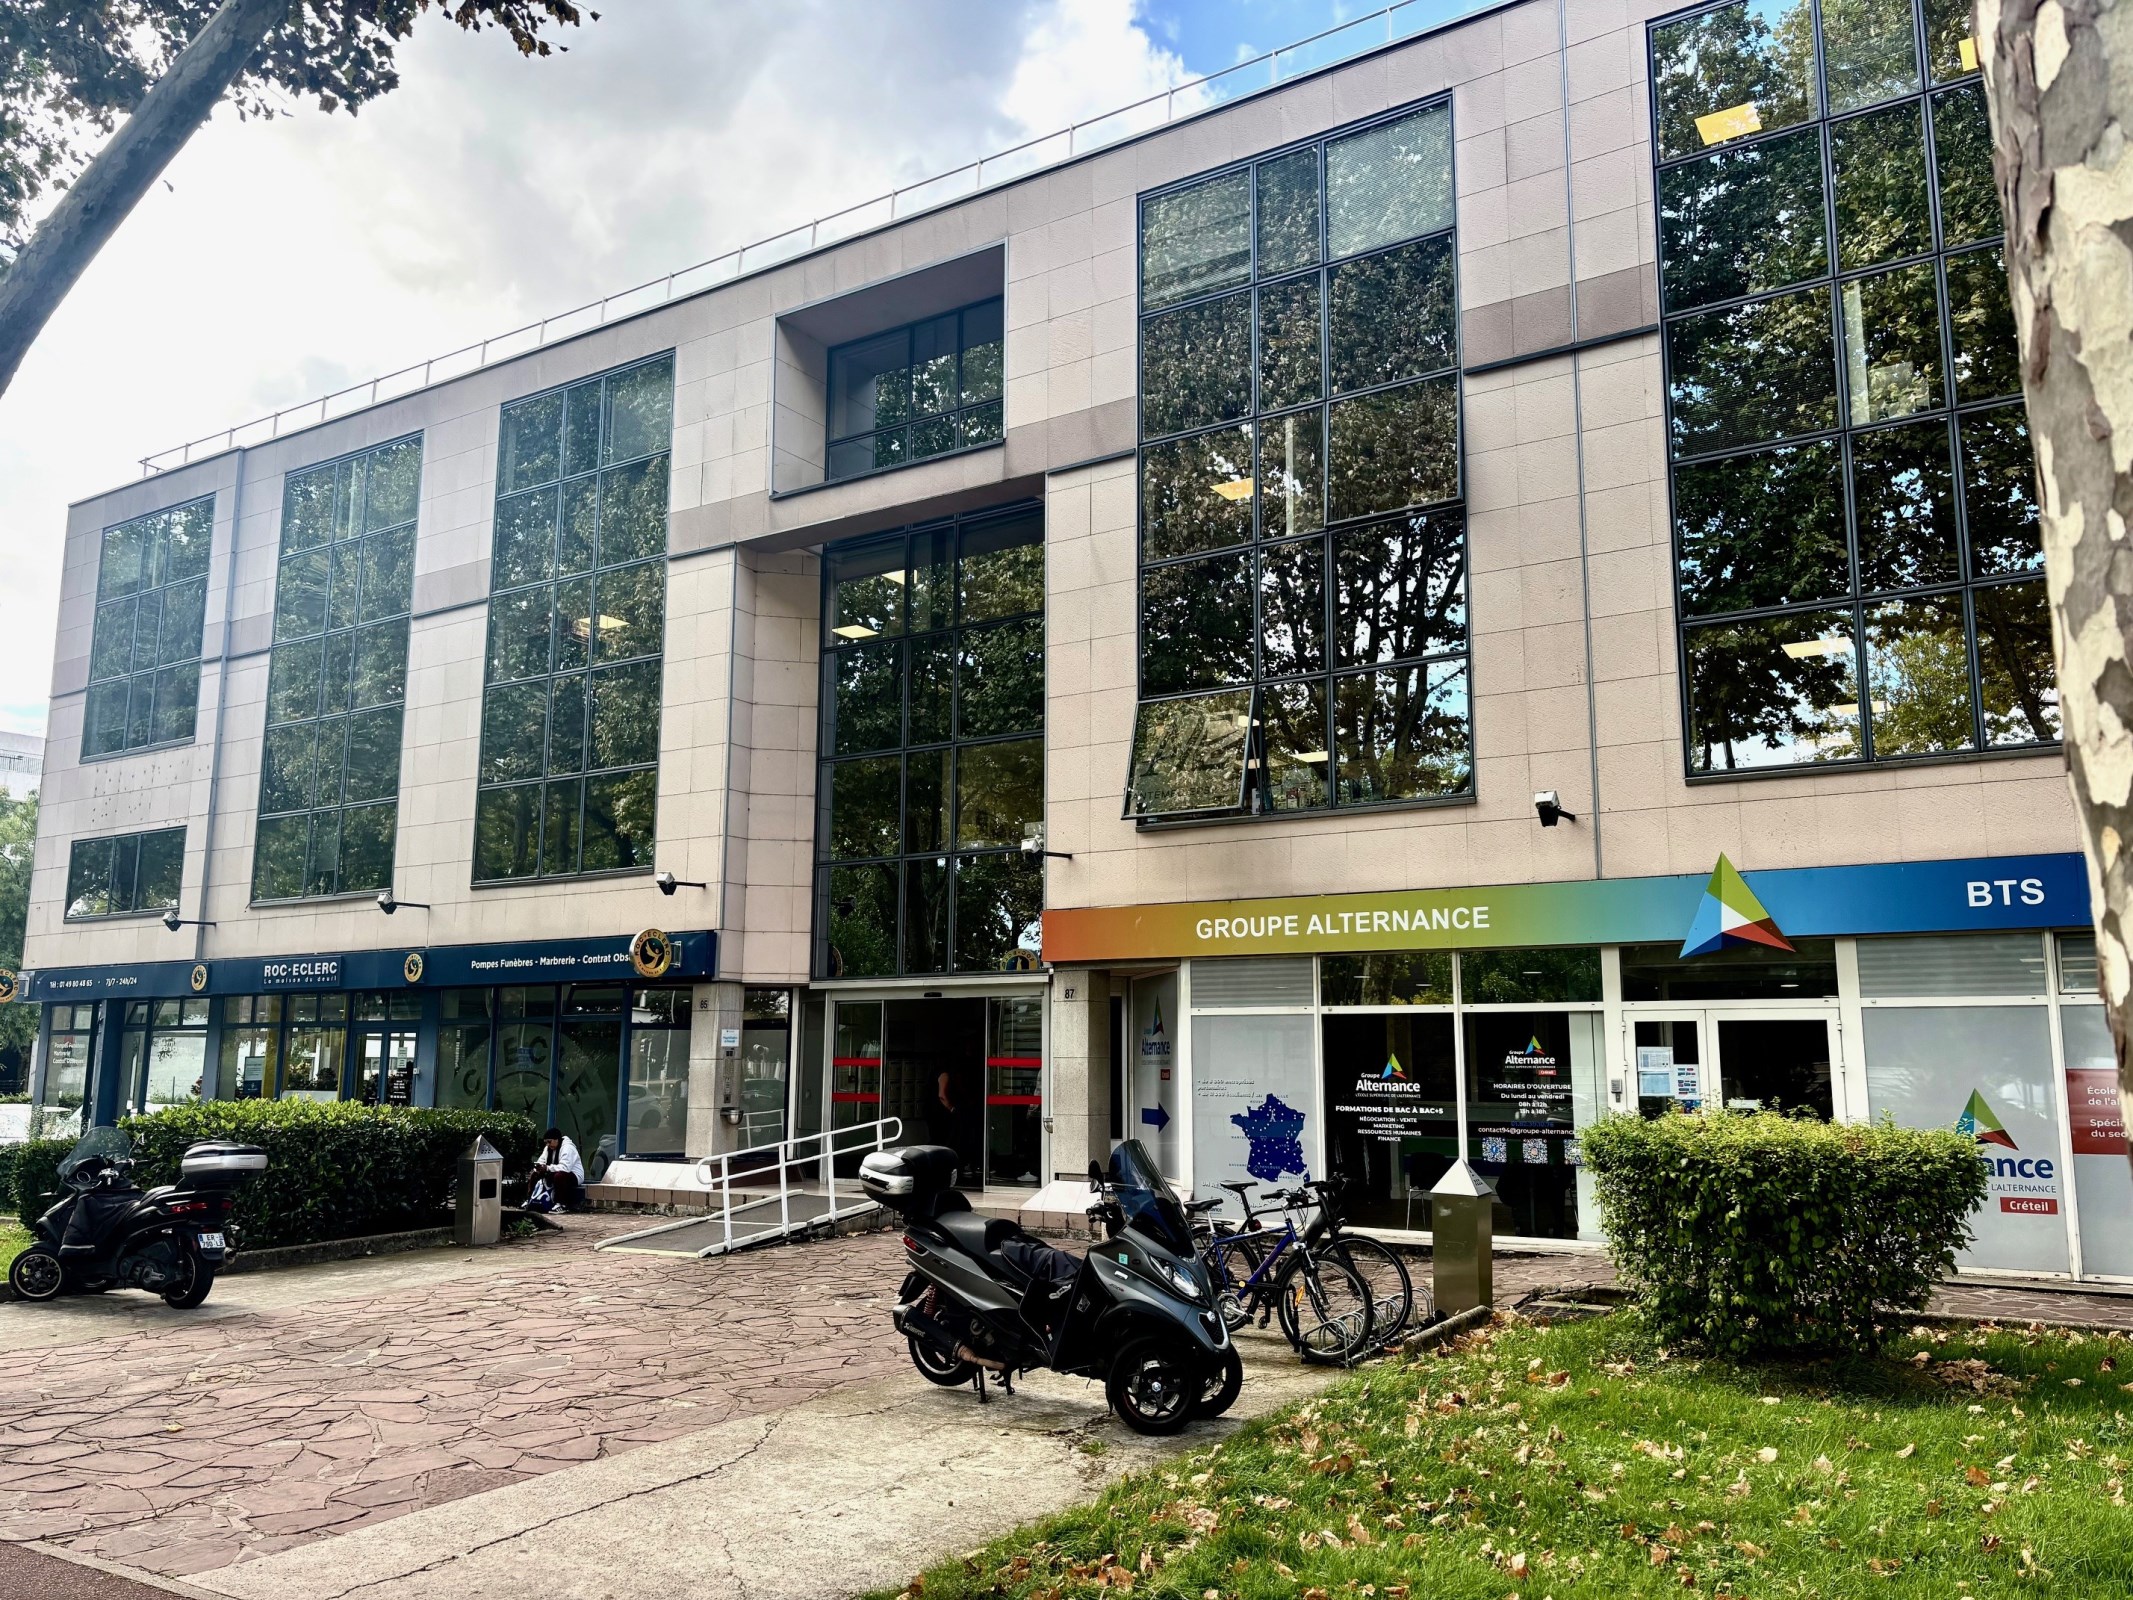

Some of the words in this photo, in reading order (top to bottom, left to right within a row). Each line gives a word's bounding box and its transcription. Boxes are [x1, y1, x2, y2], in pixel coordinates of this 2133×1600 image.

[1967, 878, 2045, 907] BTS
[1196, 915, 1299, 939] GROUPE
[1306, 906, 1490, 935] ALTERNANCE
[471, 960, 498, 970] Pompes
[500, 958, 534, 968] Funèbres
[540, 955, 575, 966] Marbrerie
[582, 954, 611, 964] Contrat
[275, 976, 300, 984] maison
[1065, 989, 1075, 999] 87
[1505, 1055, 1555, 1064] Alternance
[1356, 1079, 1420, 1092] Alternance
[2087, 1085, 2116, 1095] École
[1335, 1105, 1382, 1113] FORMATIONS
[1412, 1106, 1418, 1114] À
[2091, 1130, 2105, 1138] du
[1991, 1184, 2056, 1193] L'ALTERNANCE
[2010, 1200, 2048, 1212] Créteil
